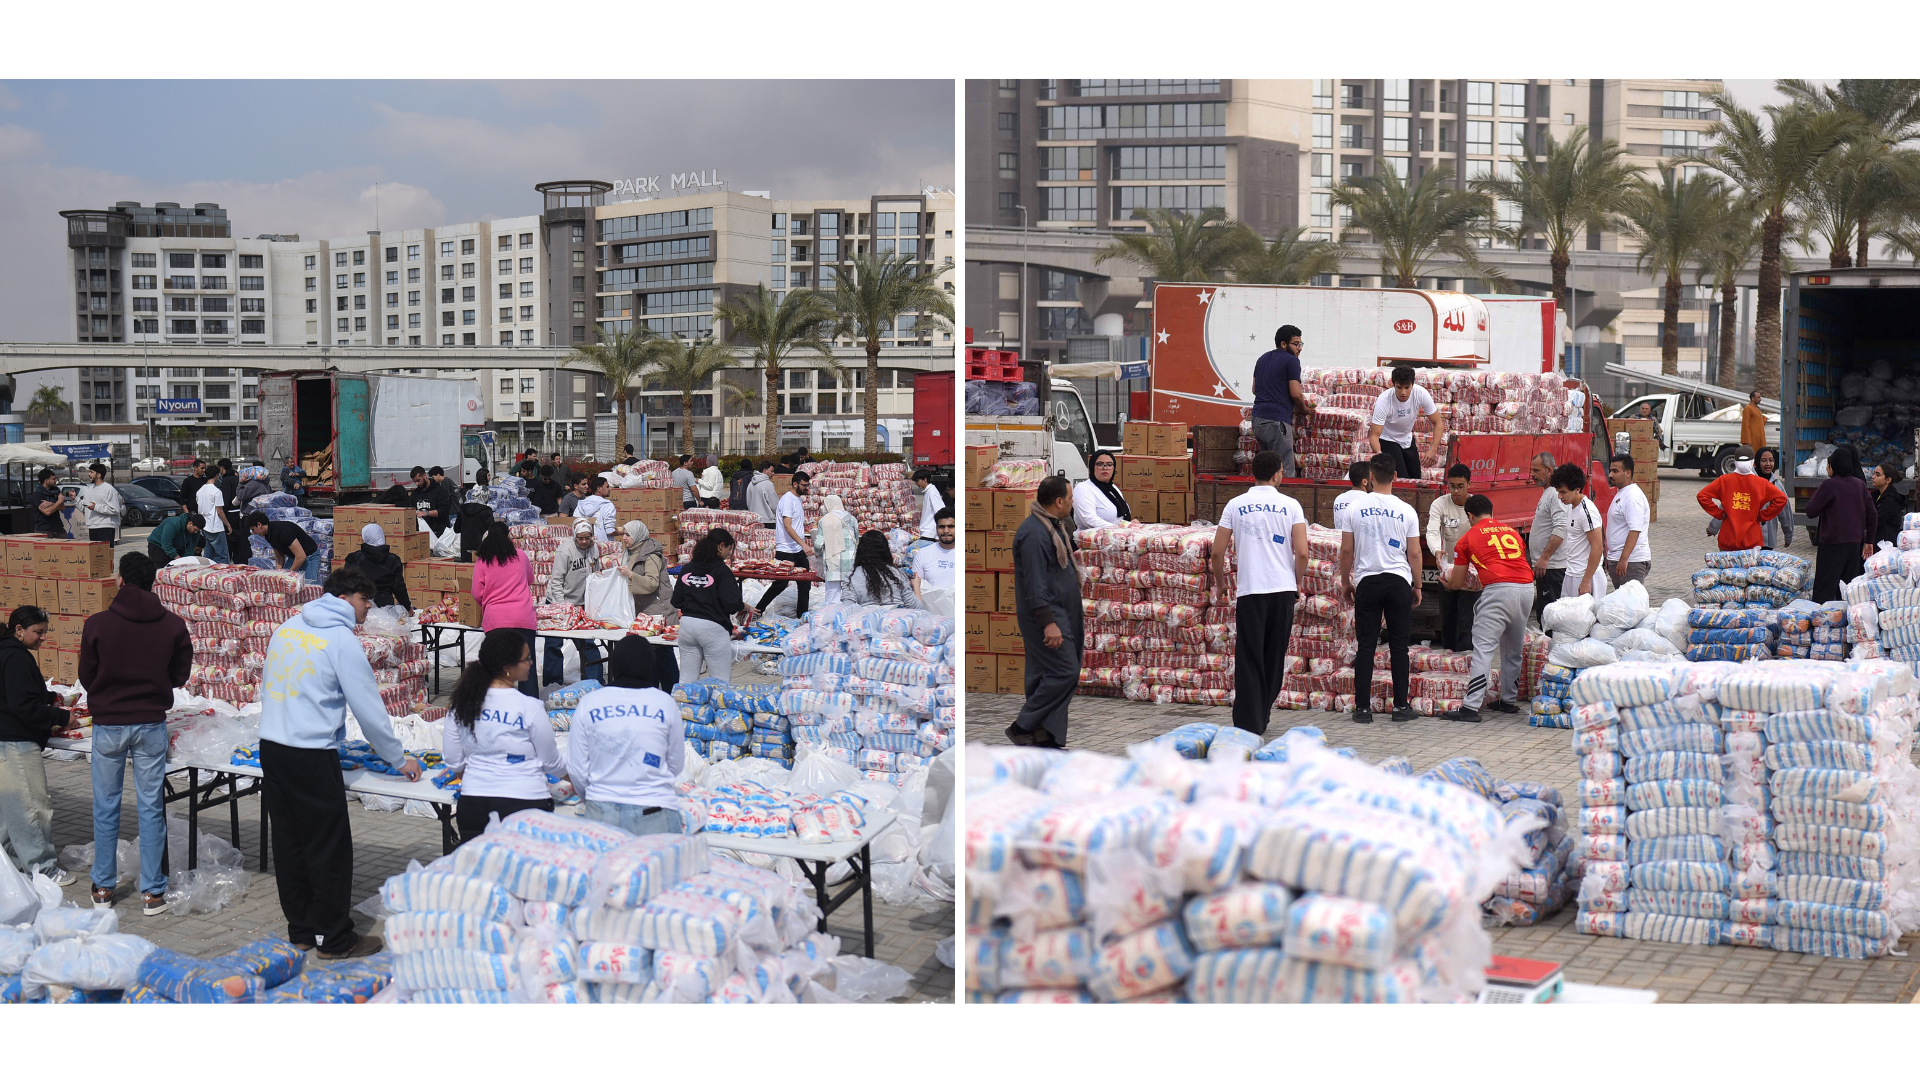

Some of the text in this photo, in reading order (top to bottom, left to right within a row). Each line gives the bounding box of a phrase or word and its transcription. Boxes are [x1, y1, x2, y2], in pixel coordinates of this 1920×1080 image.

[613, 168, 724, 196] PARK MALL
[1396, 321, 1414, 331] S&H
[159, 400, 198, 411] Nyoum
[1470, 458, 1495, 471] 100
[1238, 503, 1288, 517] RESALA
[1360, 507, 1404, 522] RESALA
[1487, 533, 1522, 560] 19
[277, 628, 328, 650] NOTHING
[588, 704, 666, 724] RESALA
